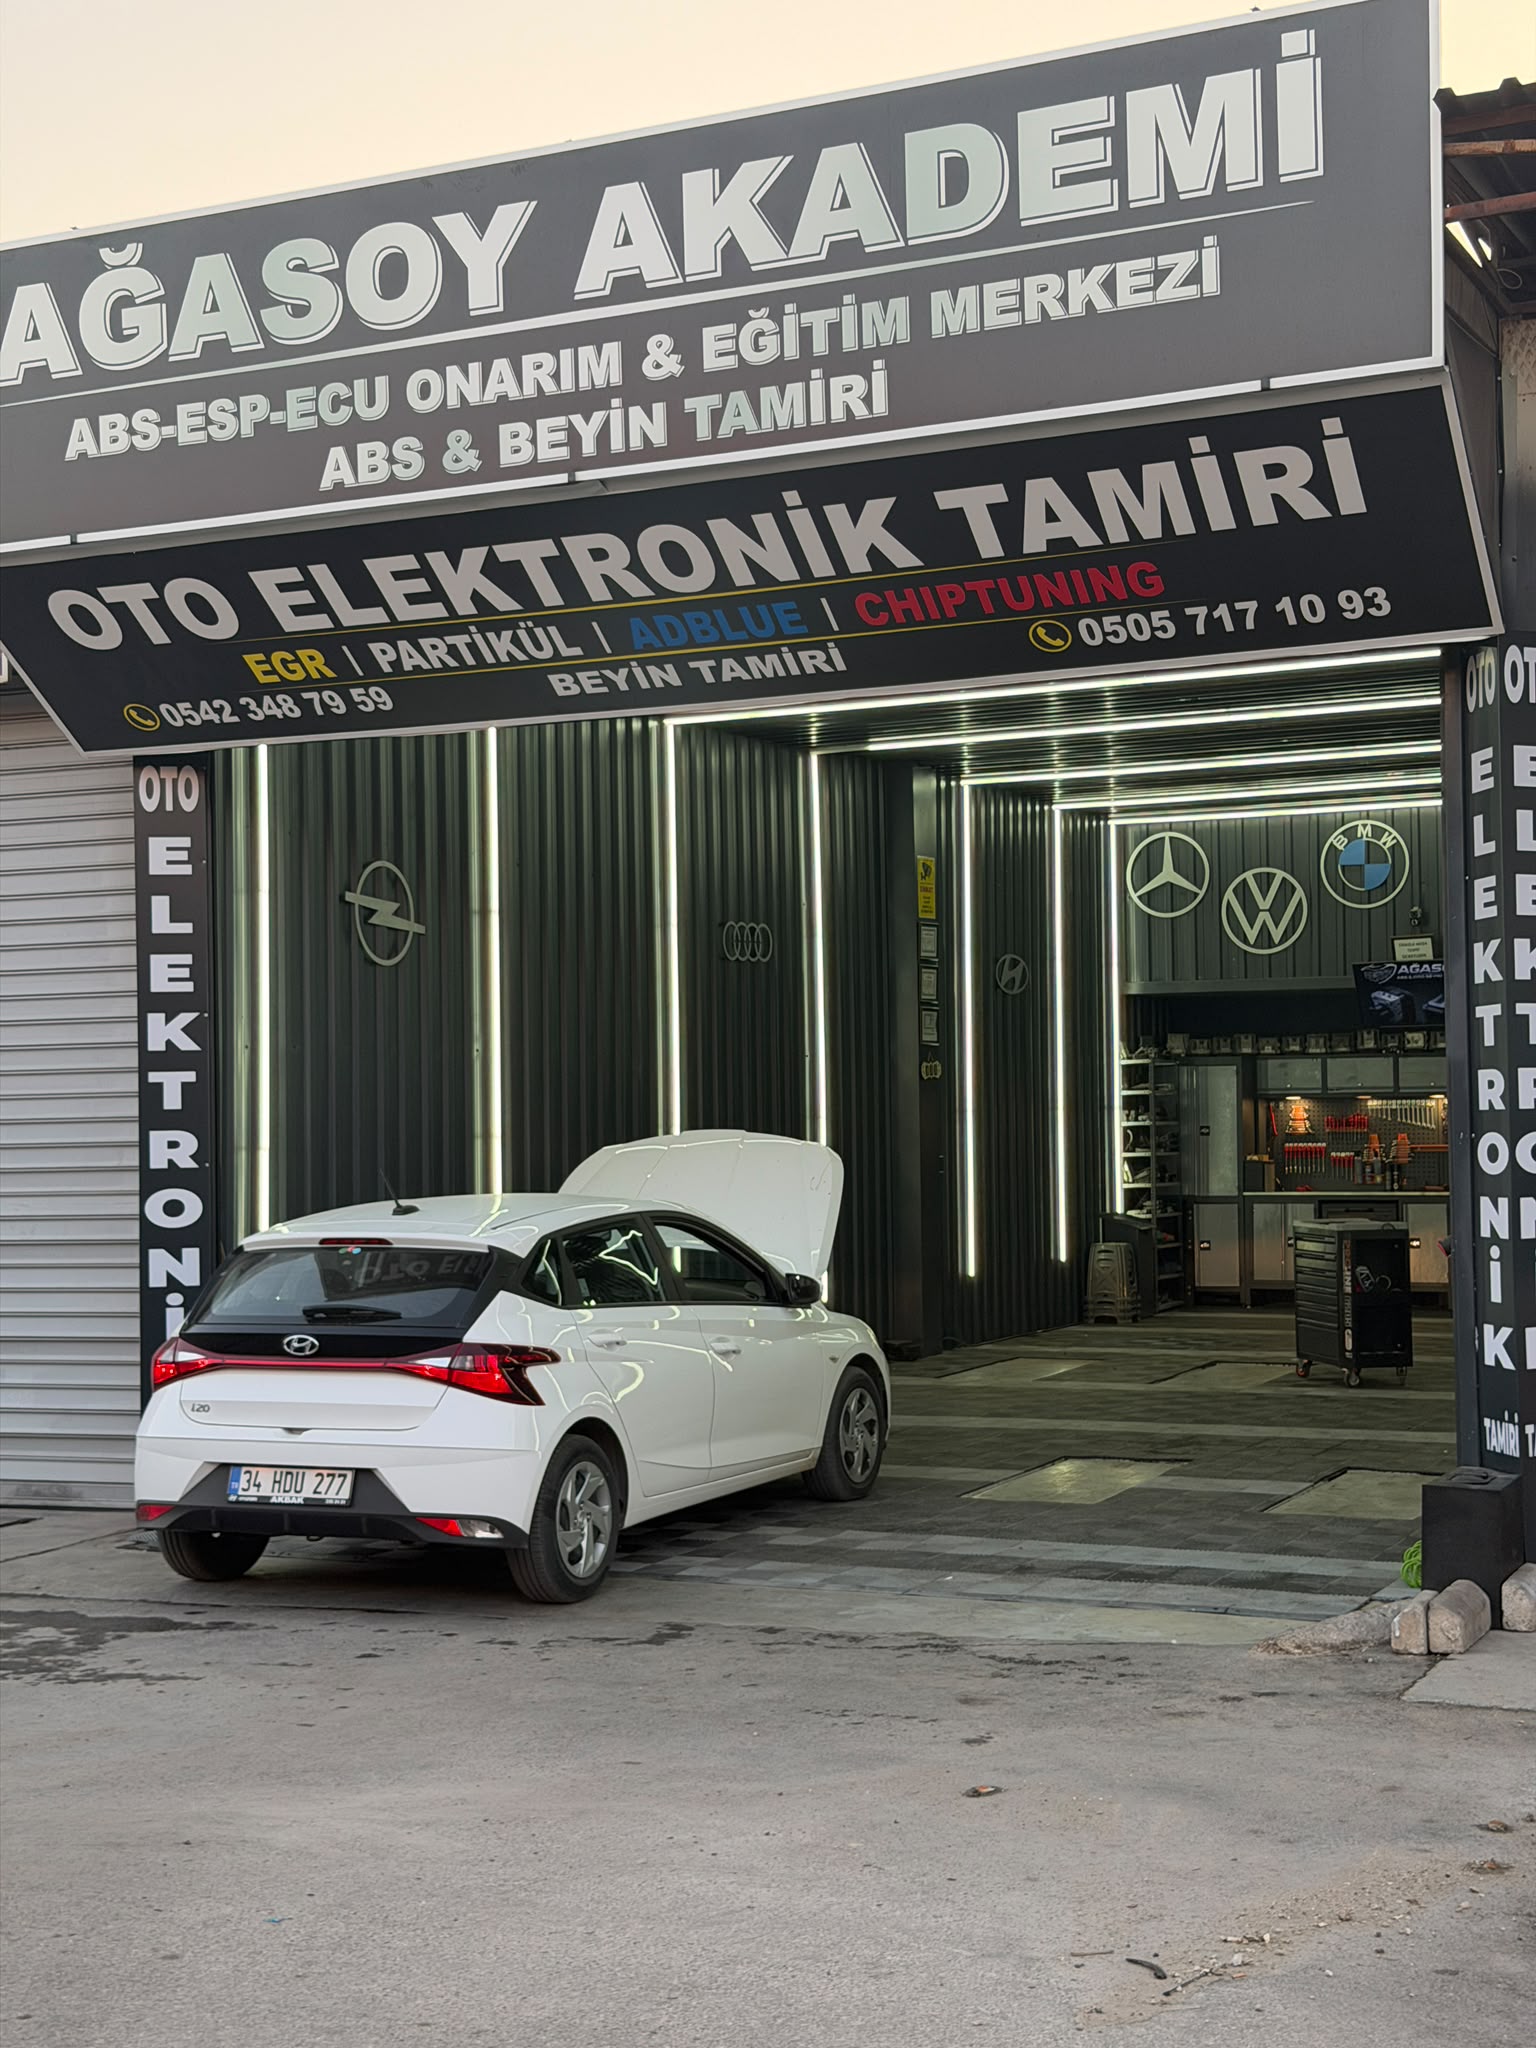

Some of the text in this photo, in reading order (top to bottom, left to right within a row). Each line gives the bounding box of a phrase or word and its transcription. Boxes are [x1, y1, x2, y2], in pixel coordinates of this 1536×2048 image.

[0, 29, 1324, 387] AĞASOY AKADEMİ
[64, 235, 1220, 461] ABS-ESP-ECU ONARIM & EĞİTİM MERKEZİ
[320, 359, 888, 491] ABS & BEYİN TAMİRİ
[48, 417, 1368, 650] OTO ELEKTRONİK TAMİRİ
[242, 561, 1165, 683] EGR PARTİKÜL ADBLUE CHIPTUNING
[1078, 586, 1392, 646] 0505 717 10 93
[547, 642, 847, 697] BEYİN TAMİRİ
[1466, 648, 1497, 713] OTO
[1504, 644, 1536, 704] OT
[159, 685, 394, 727] 0542 348 79 59
[138, 765, 200, 812] OTO
[1332, 823, 1398, 851] BMW
[1398, 963, 1444, 974] AĞAS
[1471, 746, 1516, 1371] ELEKTRONİK
[144, 836, 204, 1343] ELEKTRONİ
[1484, 1409, 1520, 1458] TAMİRİ
[241, 1470, 348, 1496] 34 HDU 277
